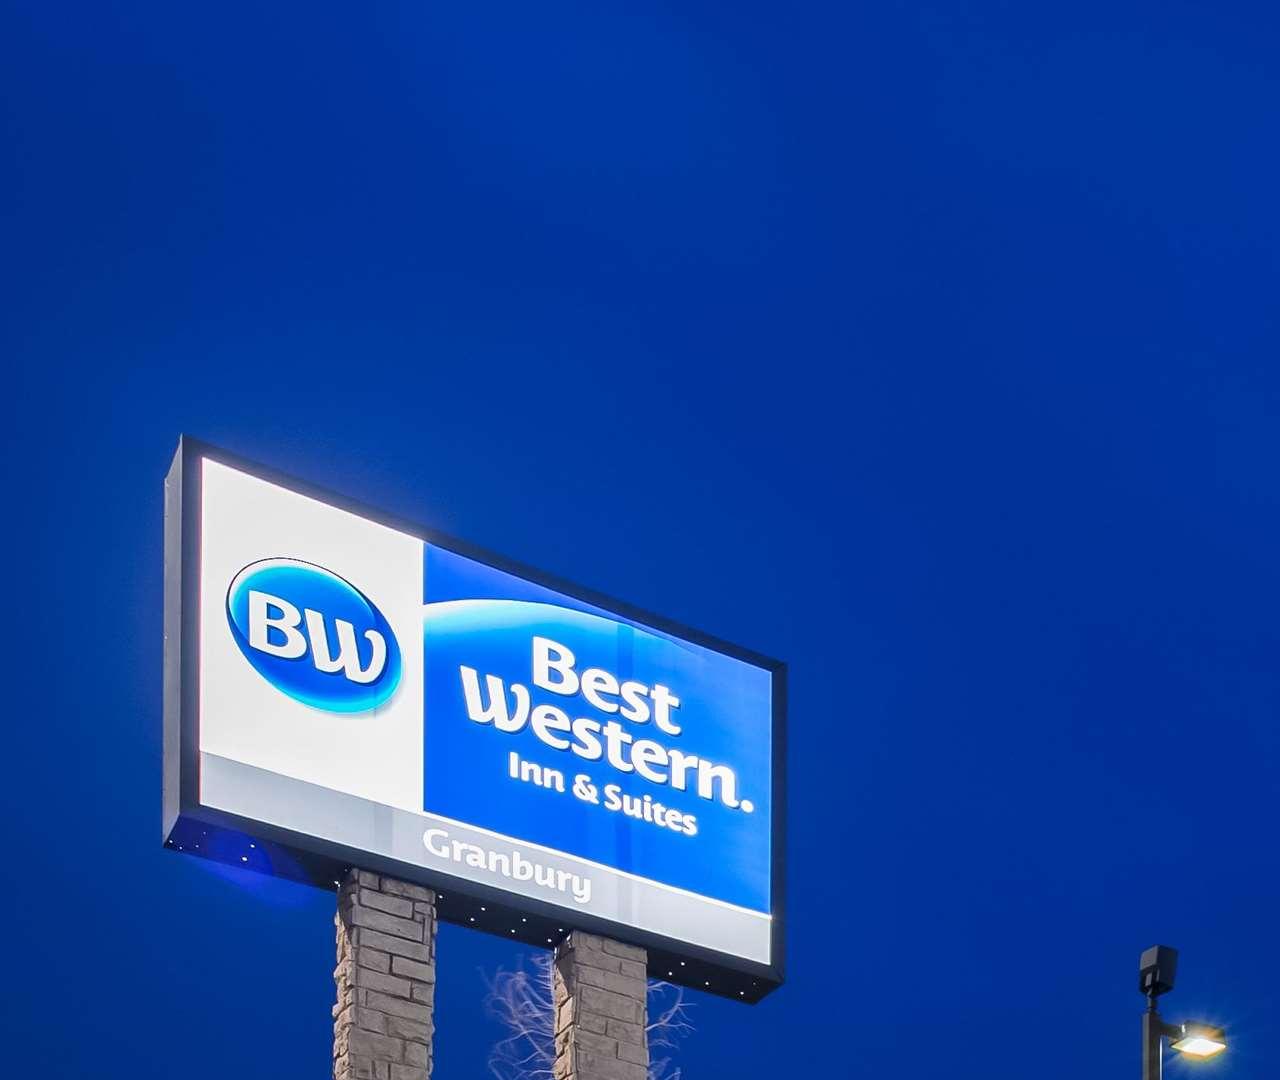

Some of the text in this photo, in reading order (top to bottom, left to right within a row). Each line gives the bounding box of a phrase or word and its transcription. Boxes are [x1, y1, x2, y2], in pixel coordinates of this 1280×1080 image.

[248, 589, 387, 684] BW
[531, 635, 682, 736] Best
[508, 751, 698, 836] Inn & Suites
[422, 828, 592, 904] Granbury
